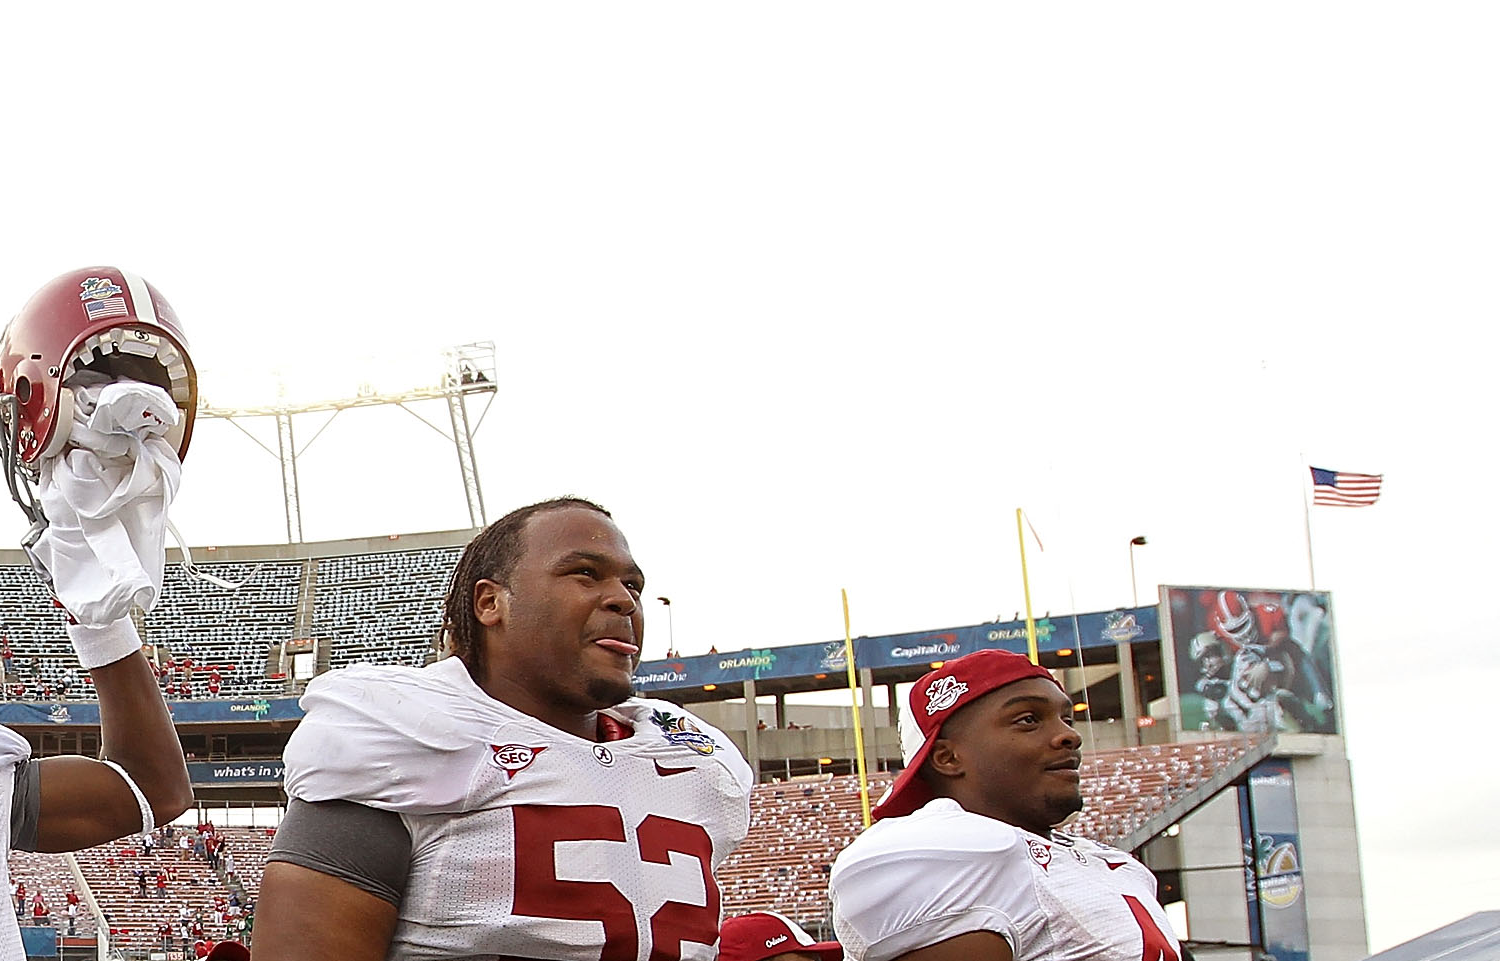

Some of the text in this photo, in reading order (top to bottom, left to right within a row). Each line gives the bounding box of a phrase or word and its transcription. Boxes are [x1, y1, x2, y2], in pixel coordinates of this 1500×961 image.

[718, 656, 771, 670] ORLANDO
[230, 704, 267, 712] ORLANDO
[498, 748, 530, 765] SEC
[213, 765, 255, 778] what's
[258, 766, 271, 777] in
[1031, 847, 1049, 859] SEC
